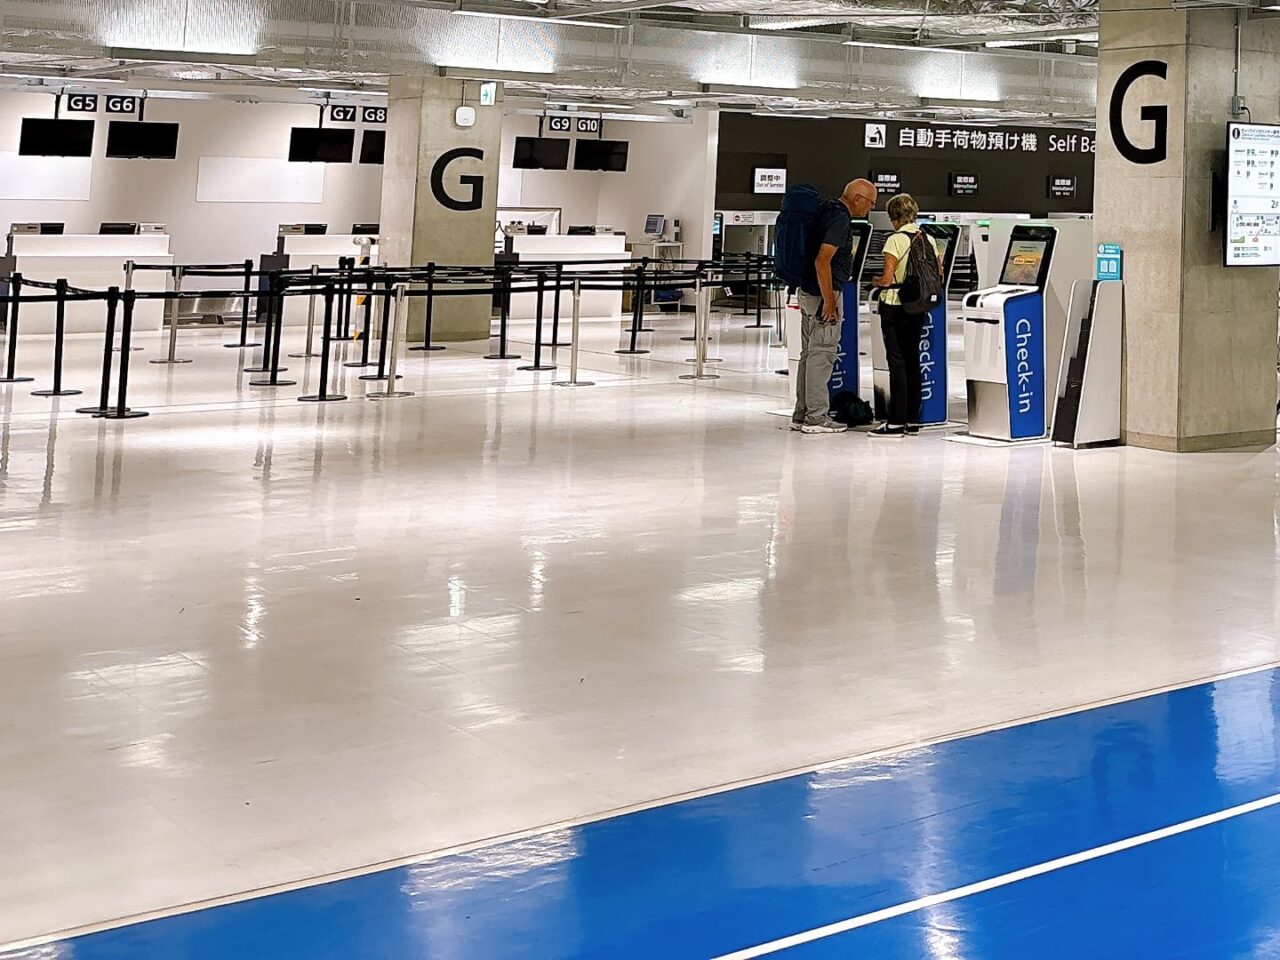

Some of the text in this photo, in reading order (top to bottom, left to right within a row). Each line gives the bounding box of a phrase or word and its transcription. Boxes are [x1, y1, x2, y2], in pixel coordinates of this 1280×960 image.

[70, 96, 95, 110] G5
[108, 98, 133, 111] G6
[332, 107, 354, 120] G7
[364, 108, 385, 121] G8
[1109, 59, 1168, 165] G
[551, 118, 570, 129] G9
[577, 119, 598, 131] G10
[899, 128, 1096, 153] 自動手荷物預け機 Self Ba
[430, 147, 484, 211] G
[1015, 318, 1034, 414] Check-in
